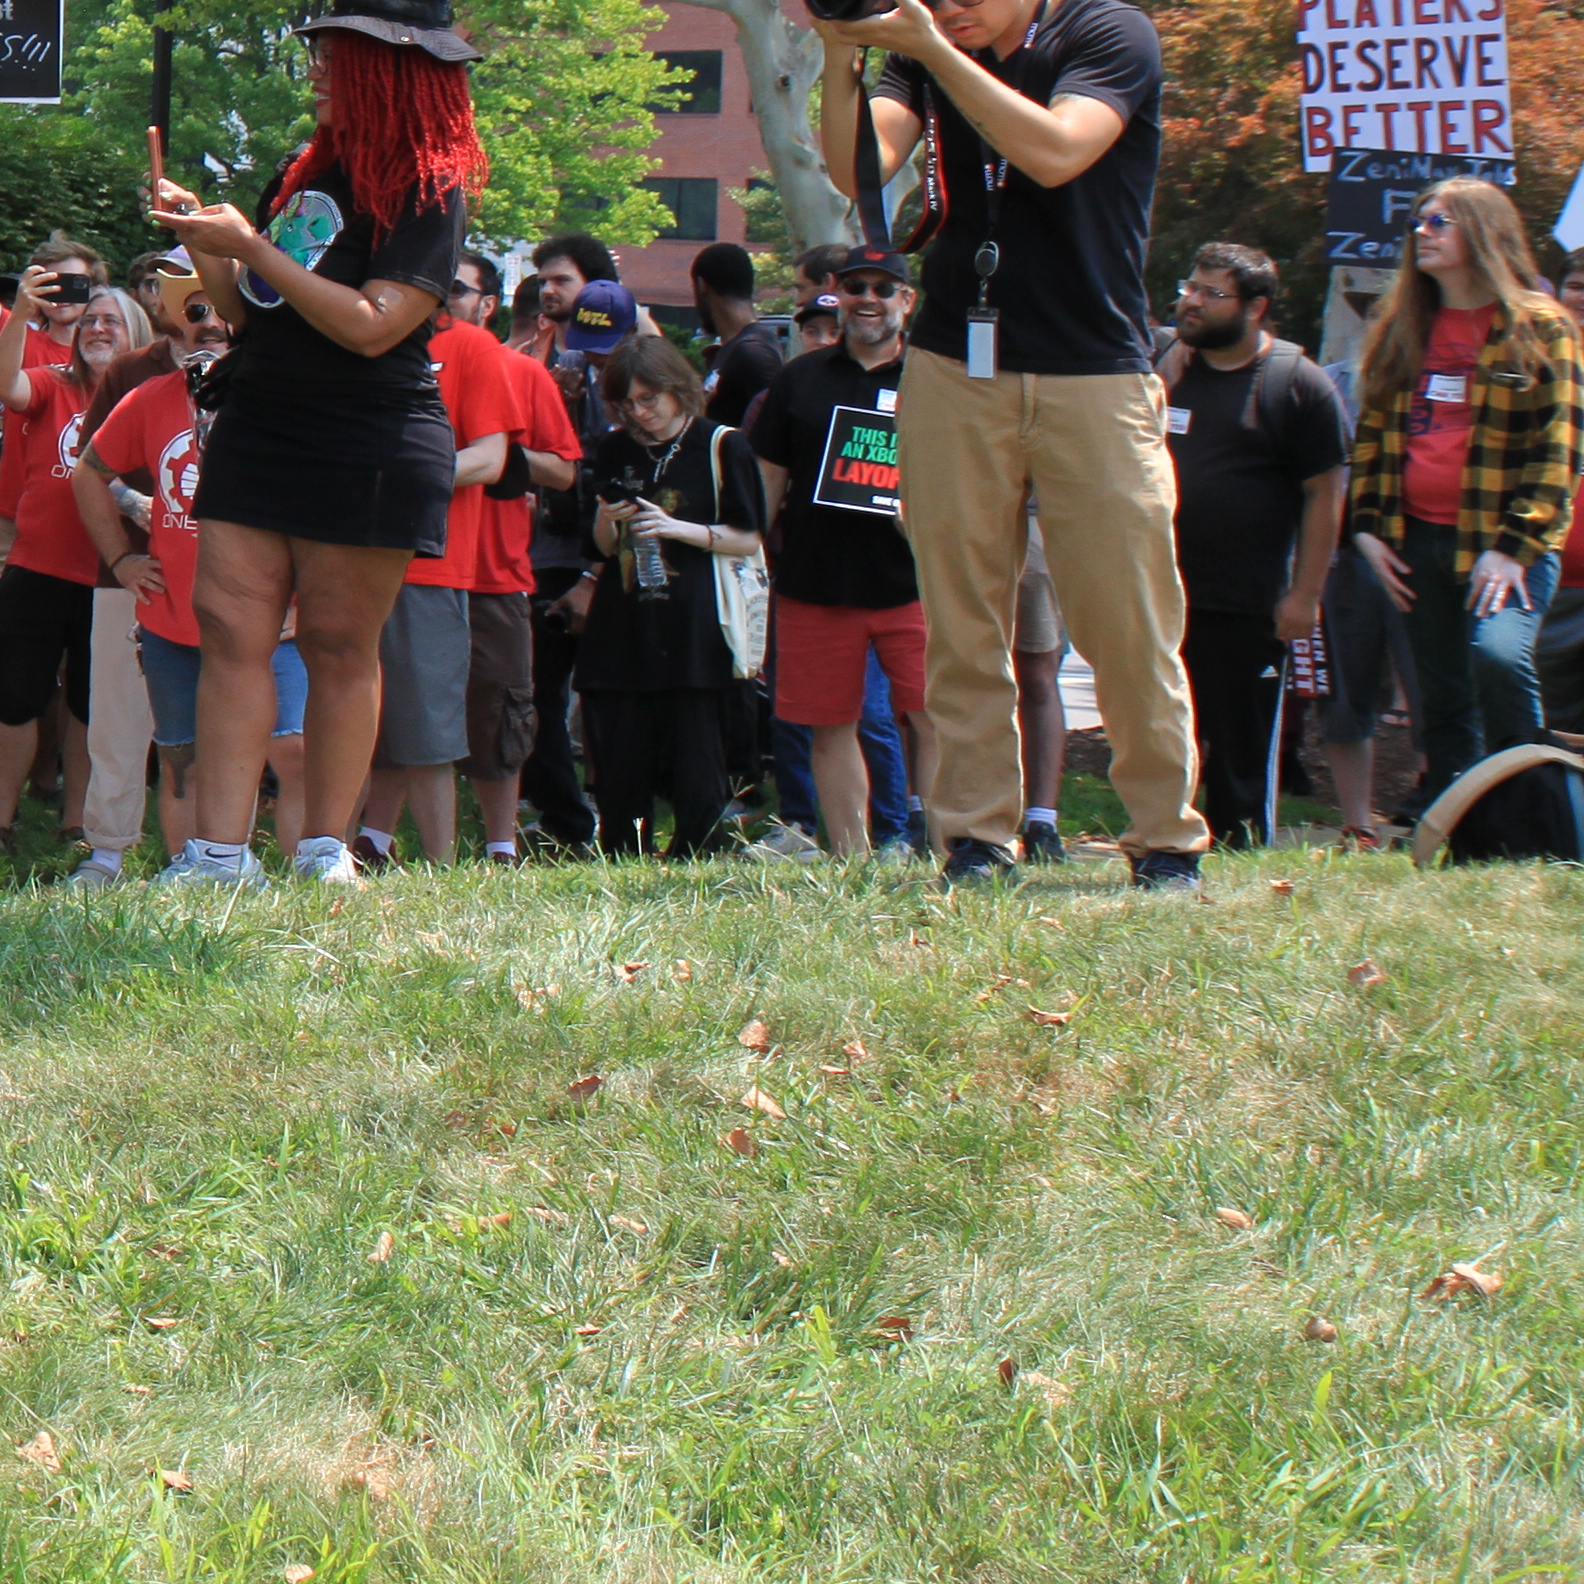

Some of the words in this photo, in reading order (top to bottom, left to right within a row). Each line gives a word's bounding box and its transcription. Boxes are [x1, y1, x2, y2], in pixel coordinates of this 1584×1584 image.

[1299, 34, 1508, 94] DESERVE
[1305, 99, 1514, 157] BETTER
[841, 441, 865, 459] AN
[851, 426, 888, 447] THIS
